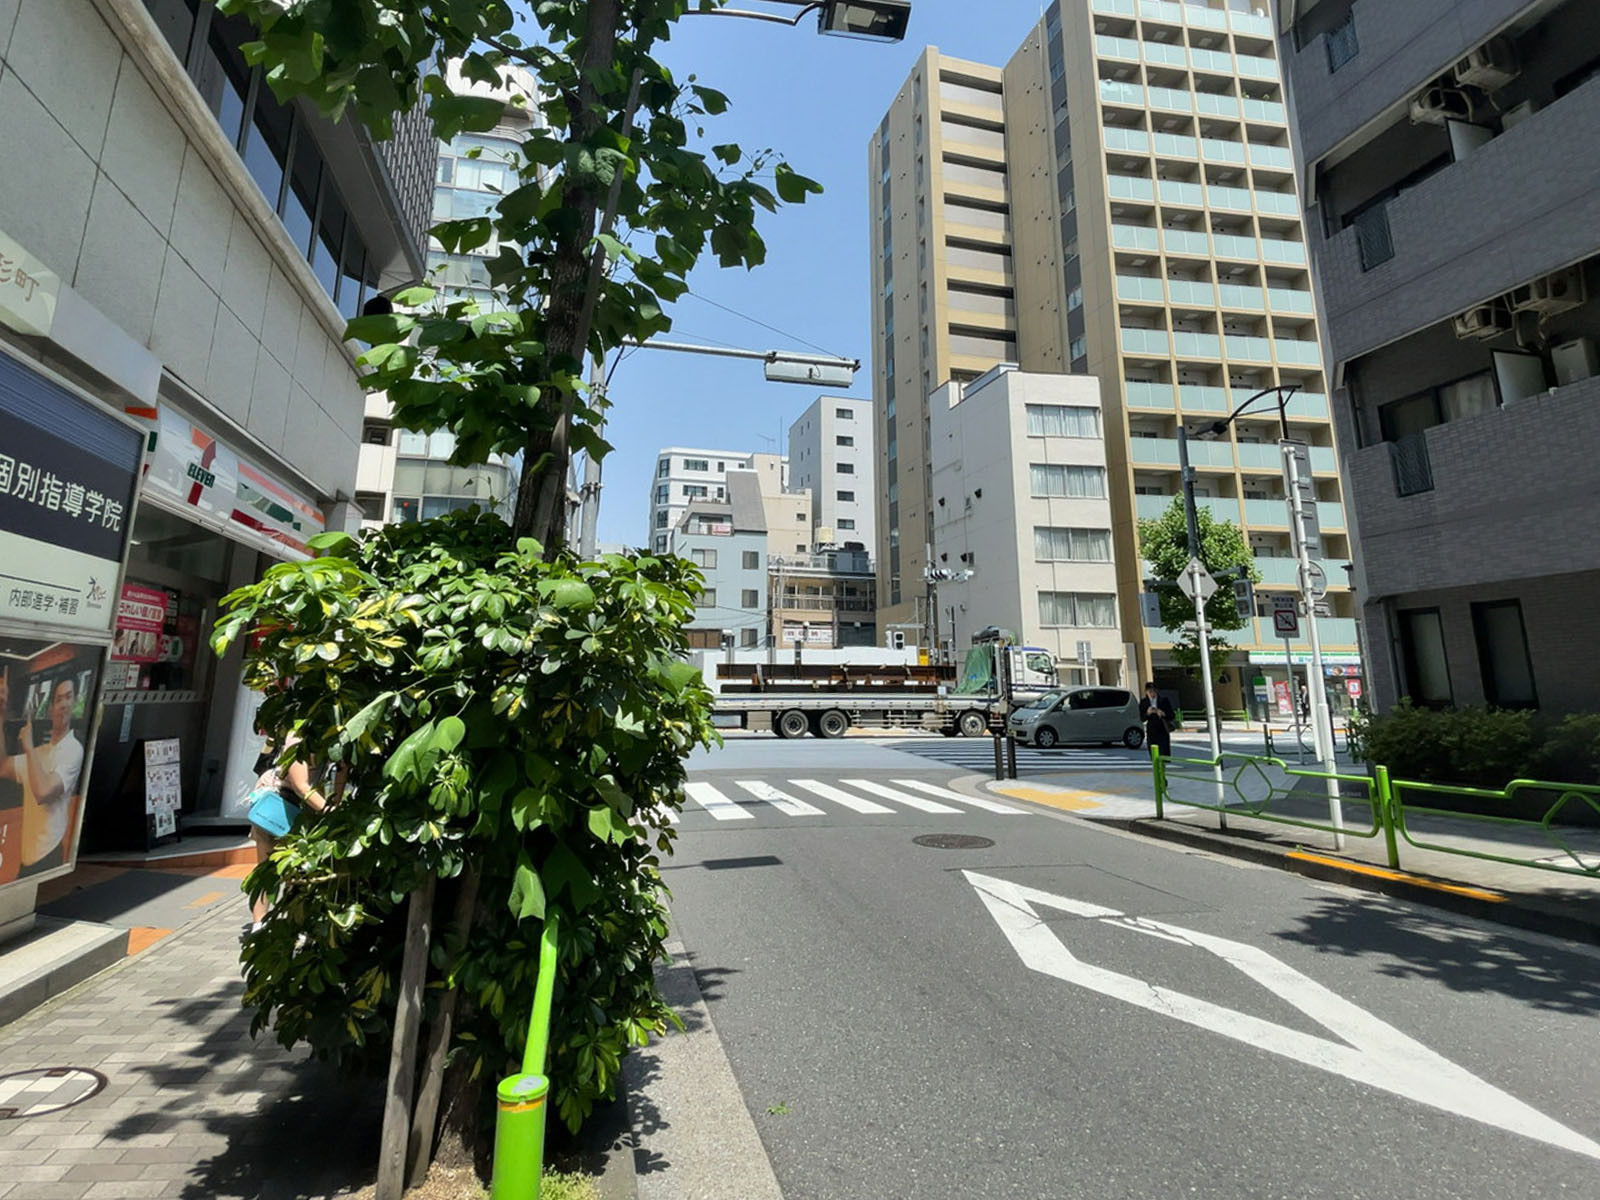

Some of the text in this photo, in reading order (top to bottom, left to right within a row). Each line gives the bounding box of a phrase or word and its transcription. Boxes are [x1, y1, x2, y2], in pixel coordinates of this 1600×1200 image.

[0, 453, 123, 531] 個別指導学院
